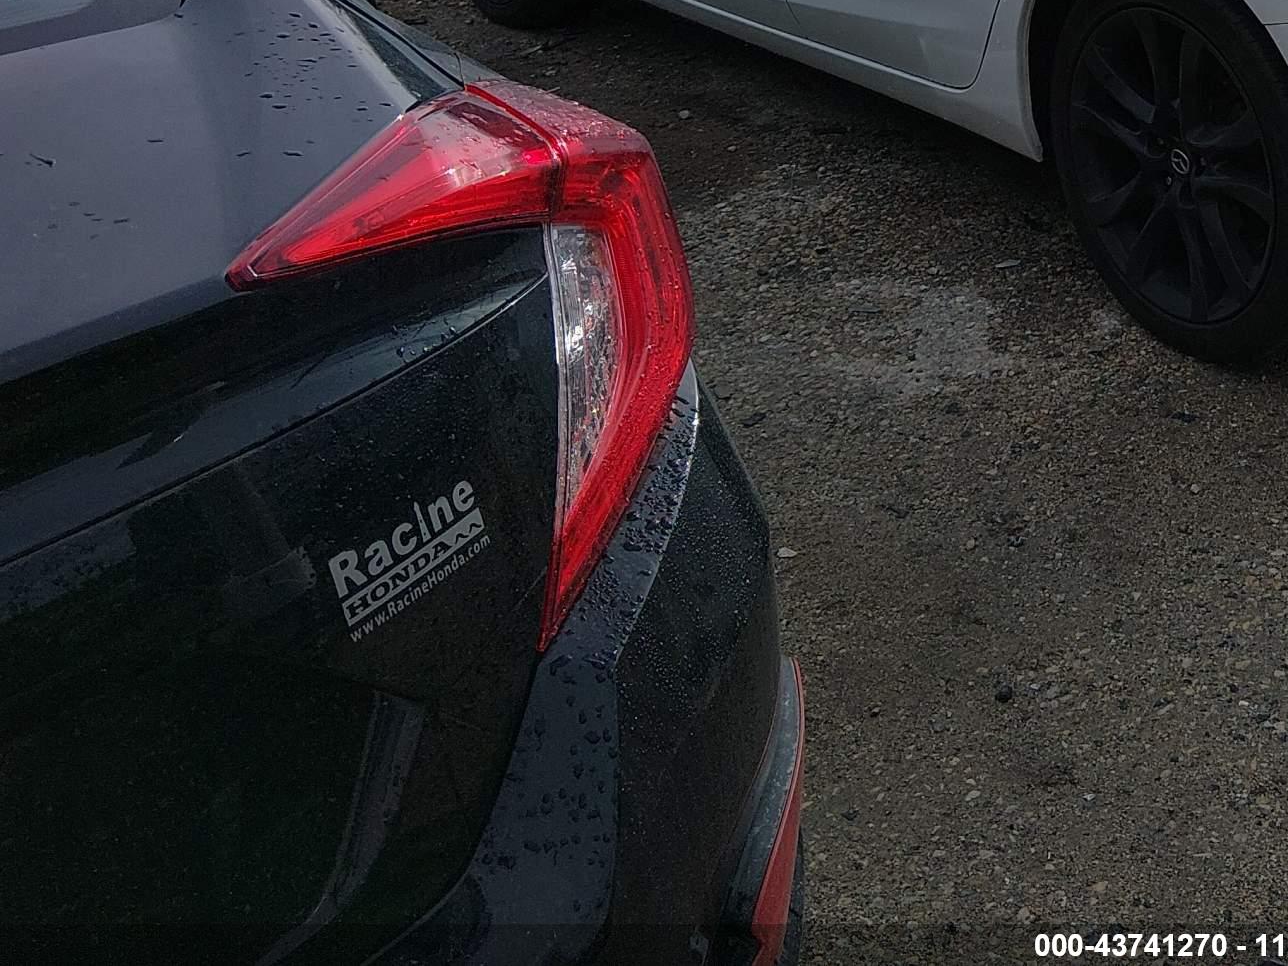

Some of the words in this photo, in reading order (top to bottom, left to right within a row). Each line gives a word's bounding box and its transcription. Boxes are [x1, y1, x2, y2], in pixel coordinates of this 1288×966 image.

[328, 480, 475, 598] Racine
[349, 540, 452, 618] HONDA
[350, 534, 491, 643] www.RacineHonda.com
